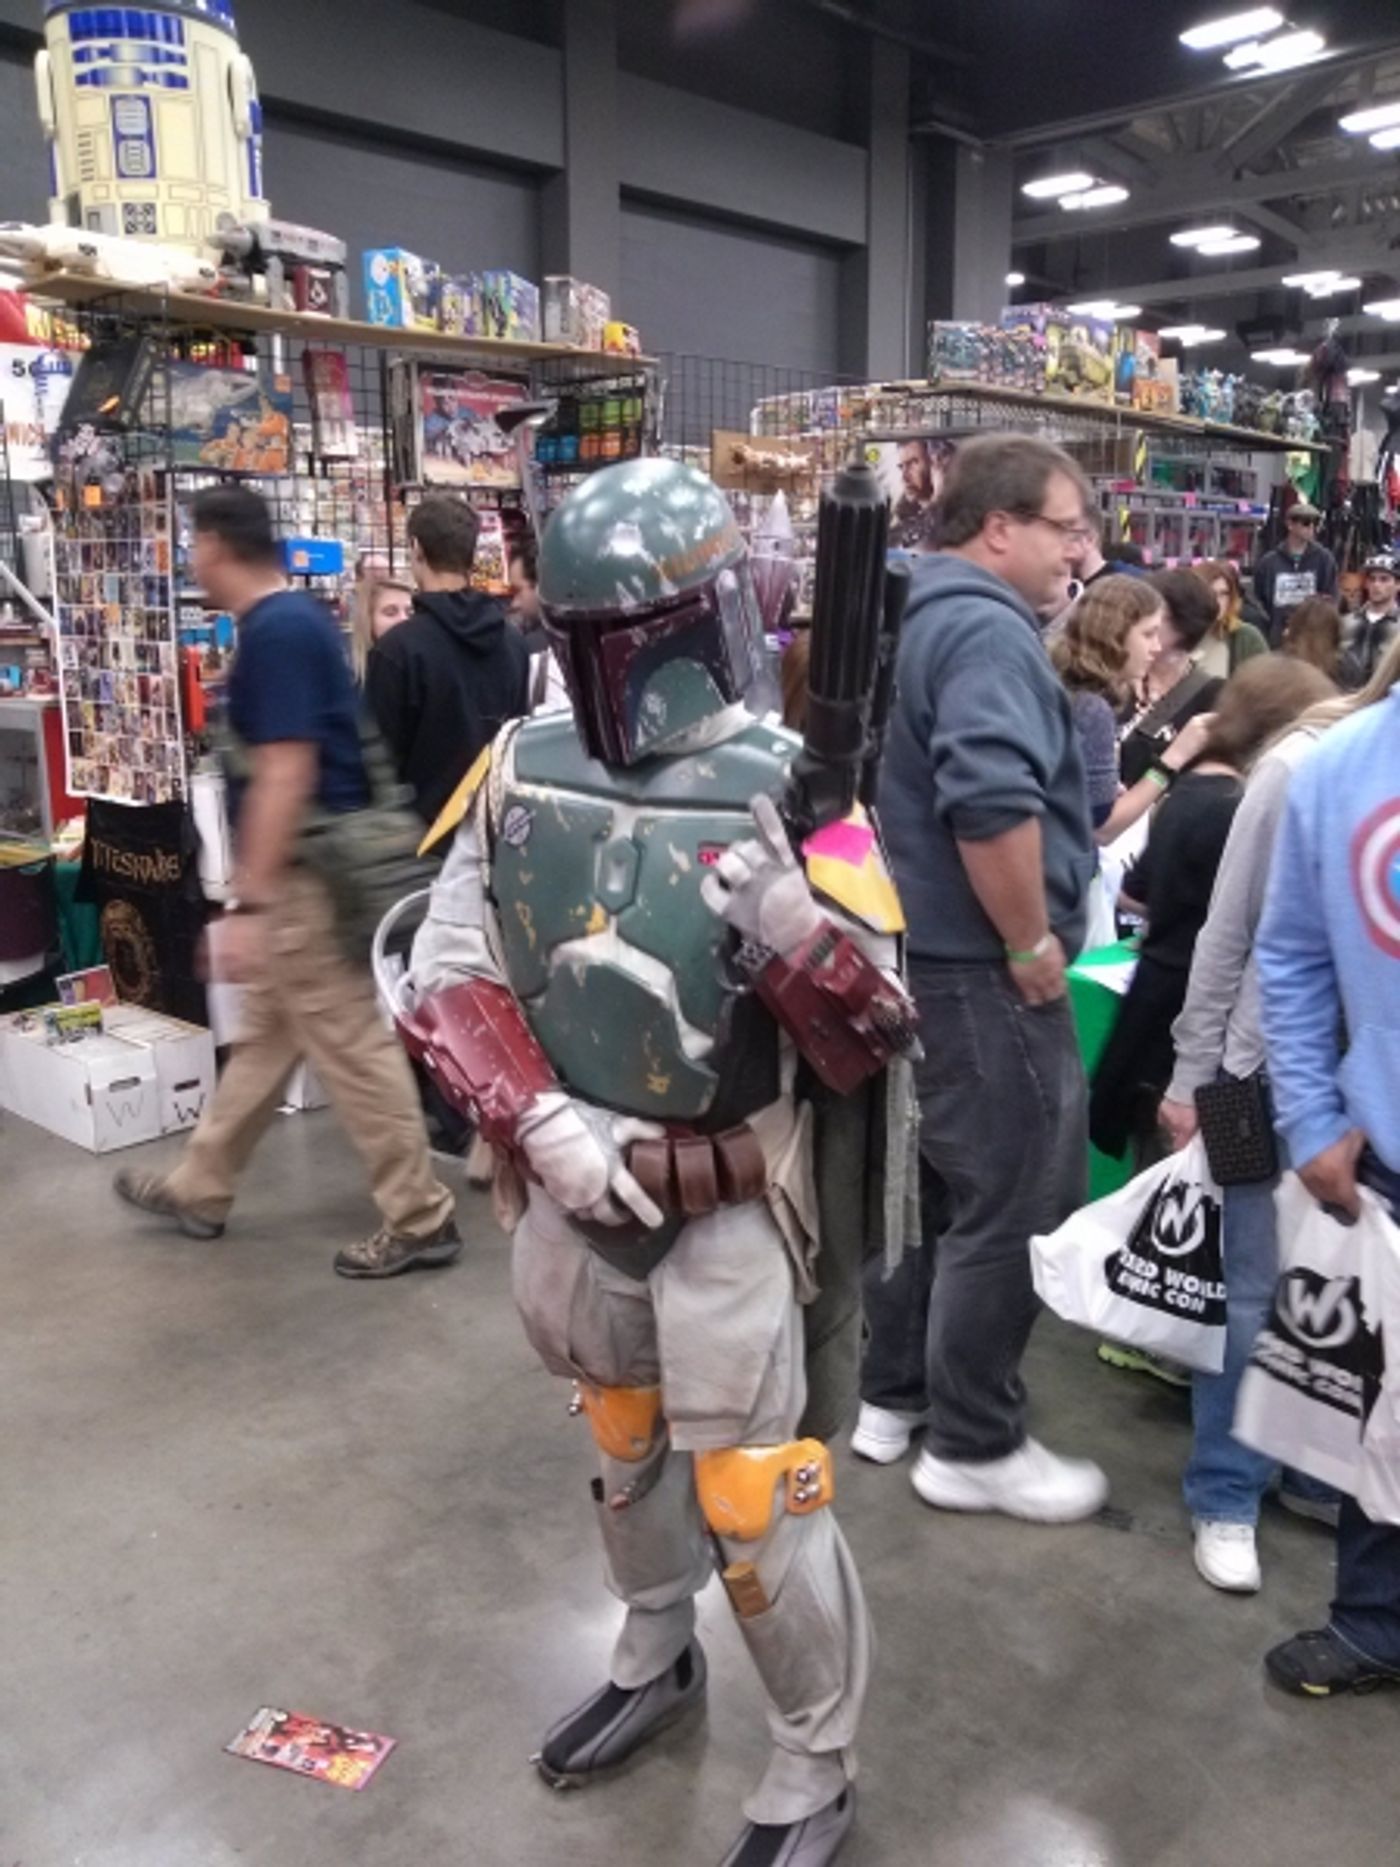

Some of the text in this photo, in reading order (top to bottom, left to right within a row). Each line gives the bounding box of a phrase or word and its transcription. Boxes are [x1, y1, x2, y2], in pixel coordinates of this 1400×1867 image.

[173, 1092, 205, 1124] W
[1164, 1288, 1207, 1314] CON
[1287, 1277, 1352, 1335] W
